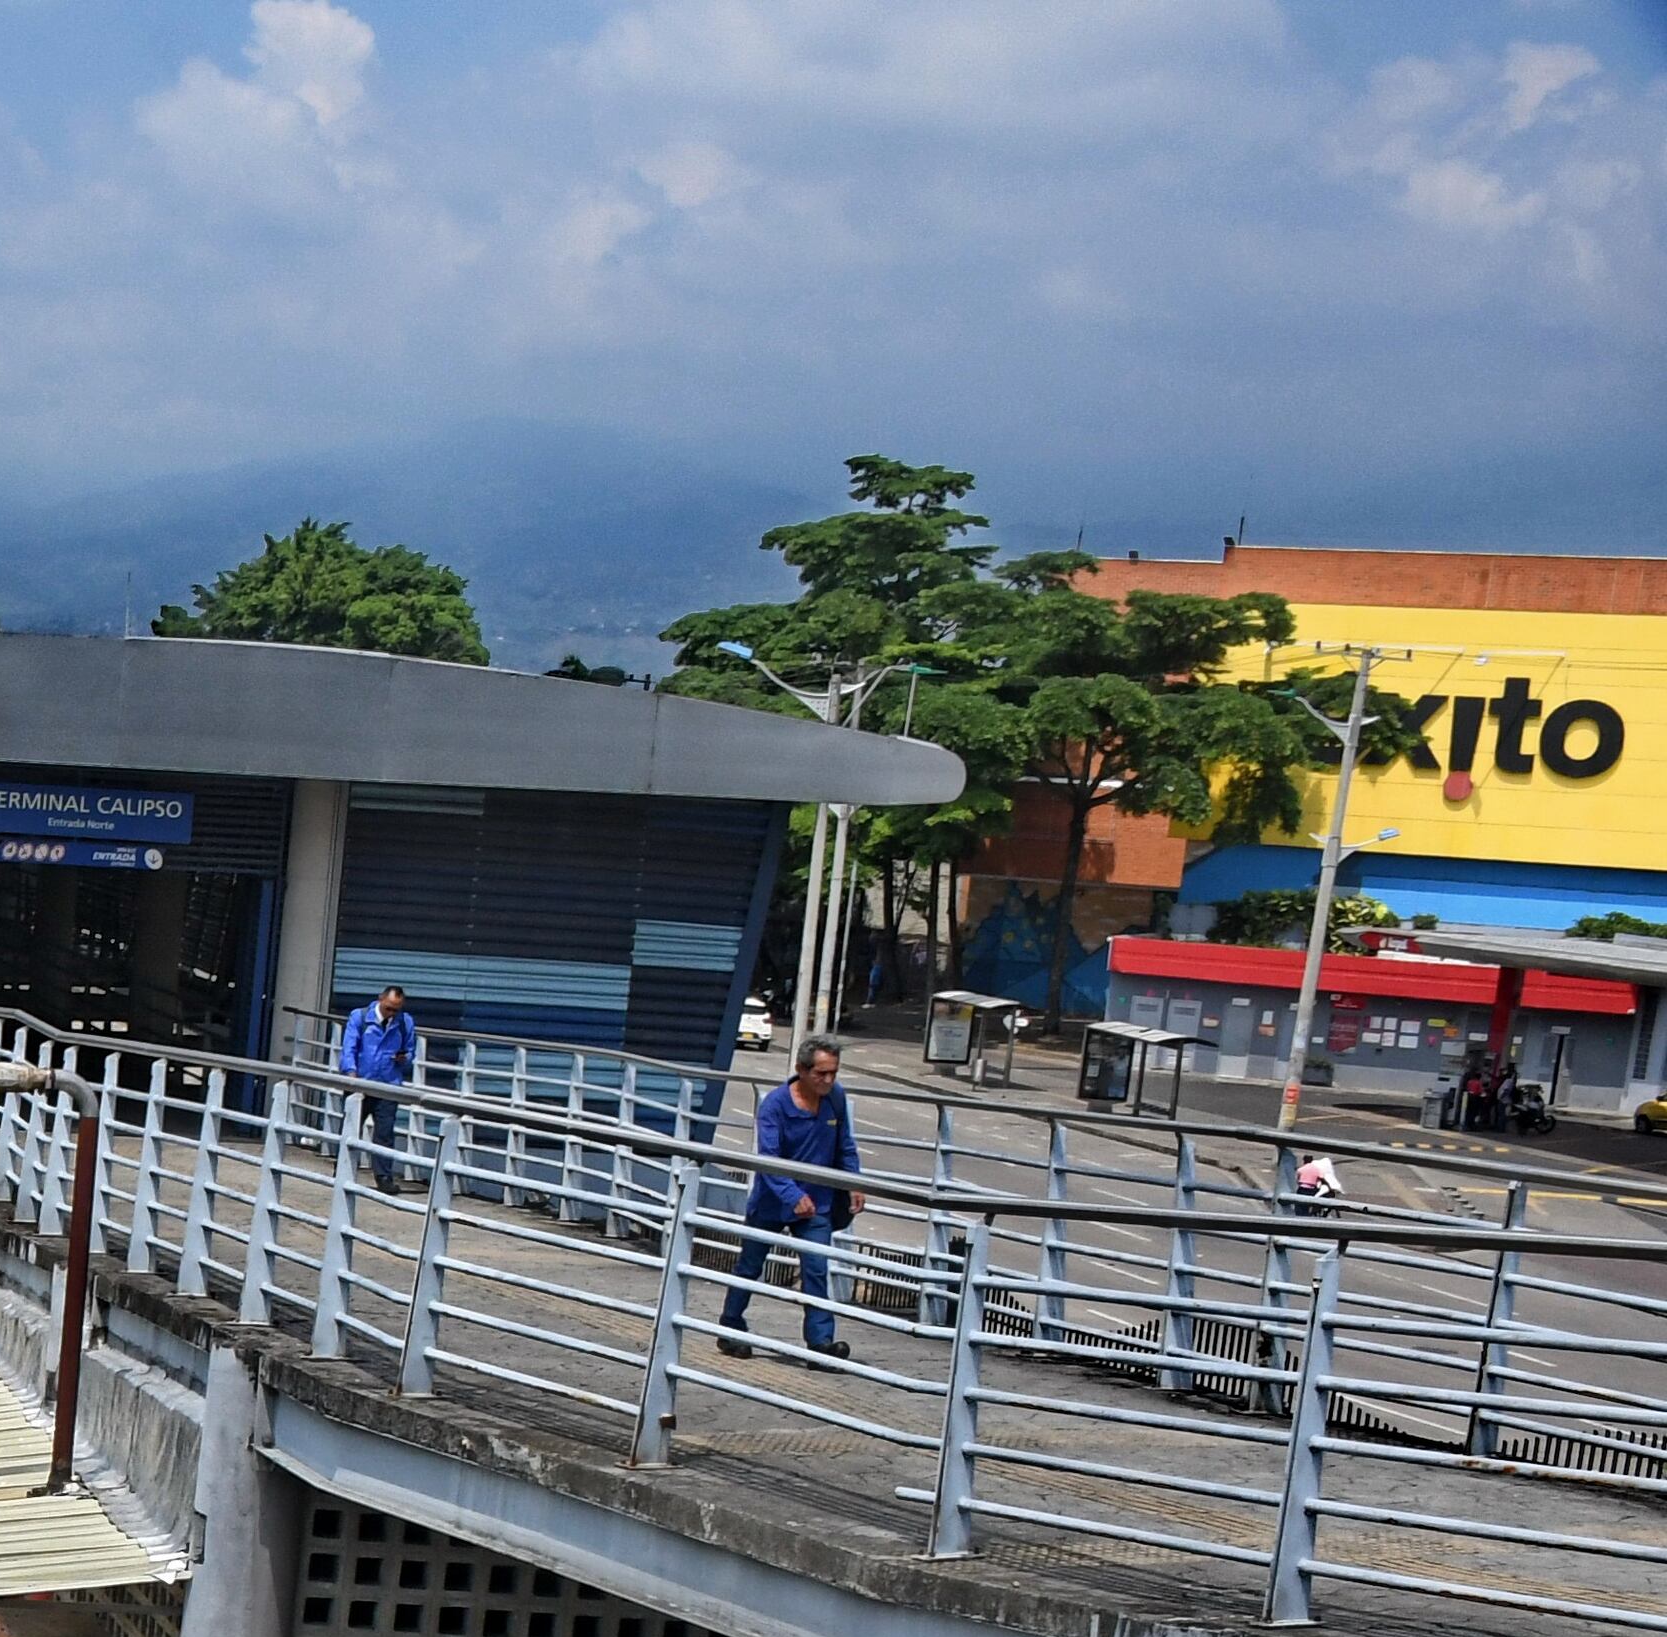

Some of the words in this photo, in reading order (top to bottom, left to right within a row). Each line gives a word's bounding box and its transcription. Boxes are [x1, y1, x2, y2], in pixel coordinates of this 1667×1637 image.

[1308, 677, 1625, 801] xito
[97, 797, 182, 818] CALIPSO
[48, 817, 85, 829] Entrada
[87, 820, 115, 831] Norte
[92, 852, 136, 861] ENTRADA
